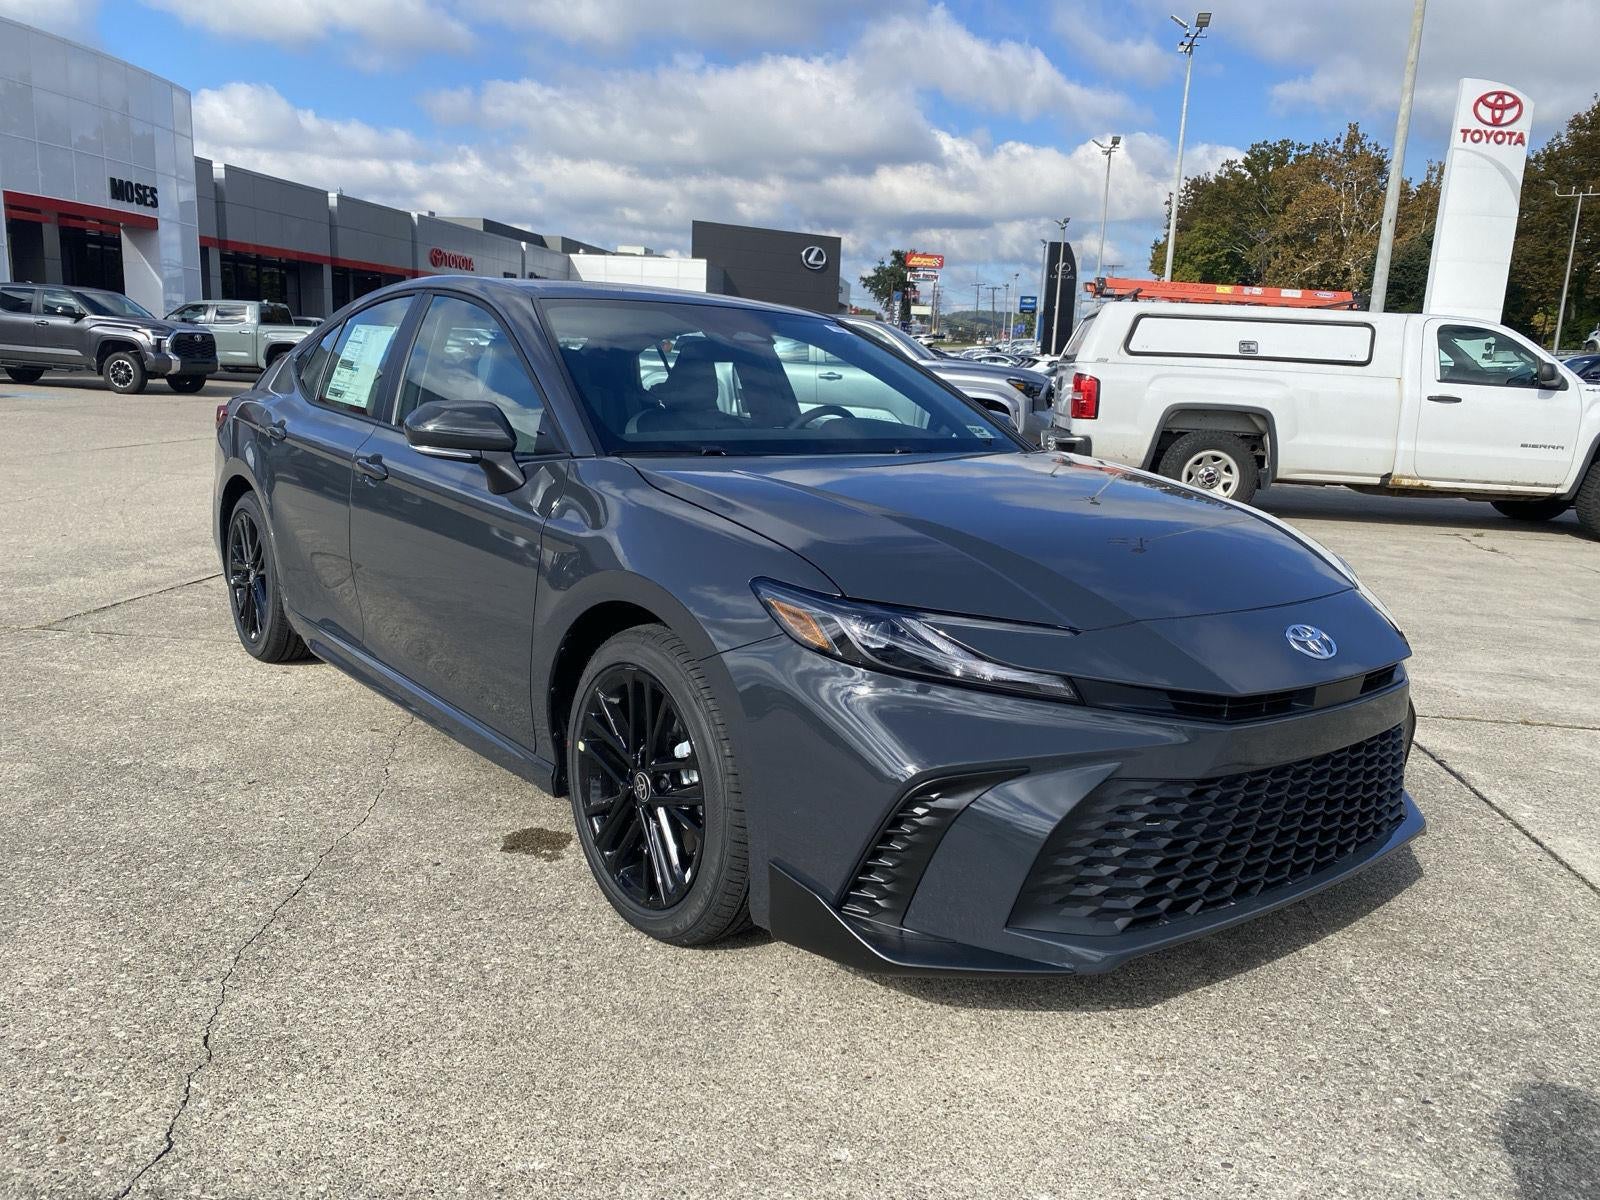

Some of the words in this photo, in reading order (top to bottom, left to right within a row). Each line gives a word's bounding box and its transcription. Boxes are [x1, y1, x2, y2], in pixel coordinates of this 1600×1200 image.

[1460, 129, 1525, 147] TOYOTA
[110, 177, 158, 208] MOSES
[443, 252, 474, 271] TOYOTA
